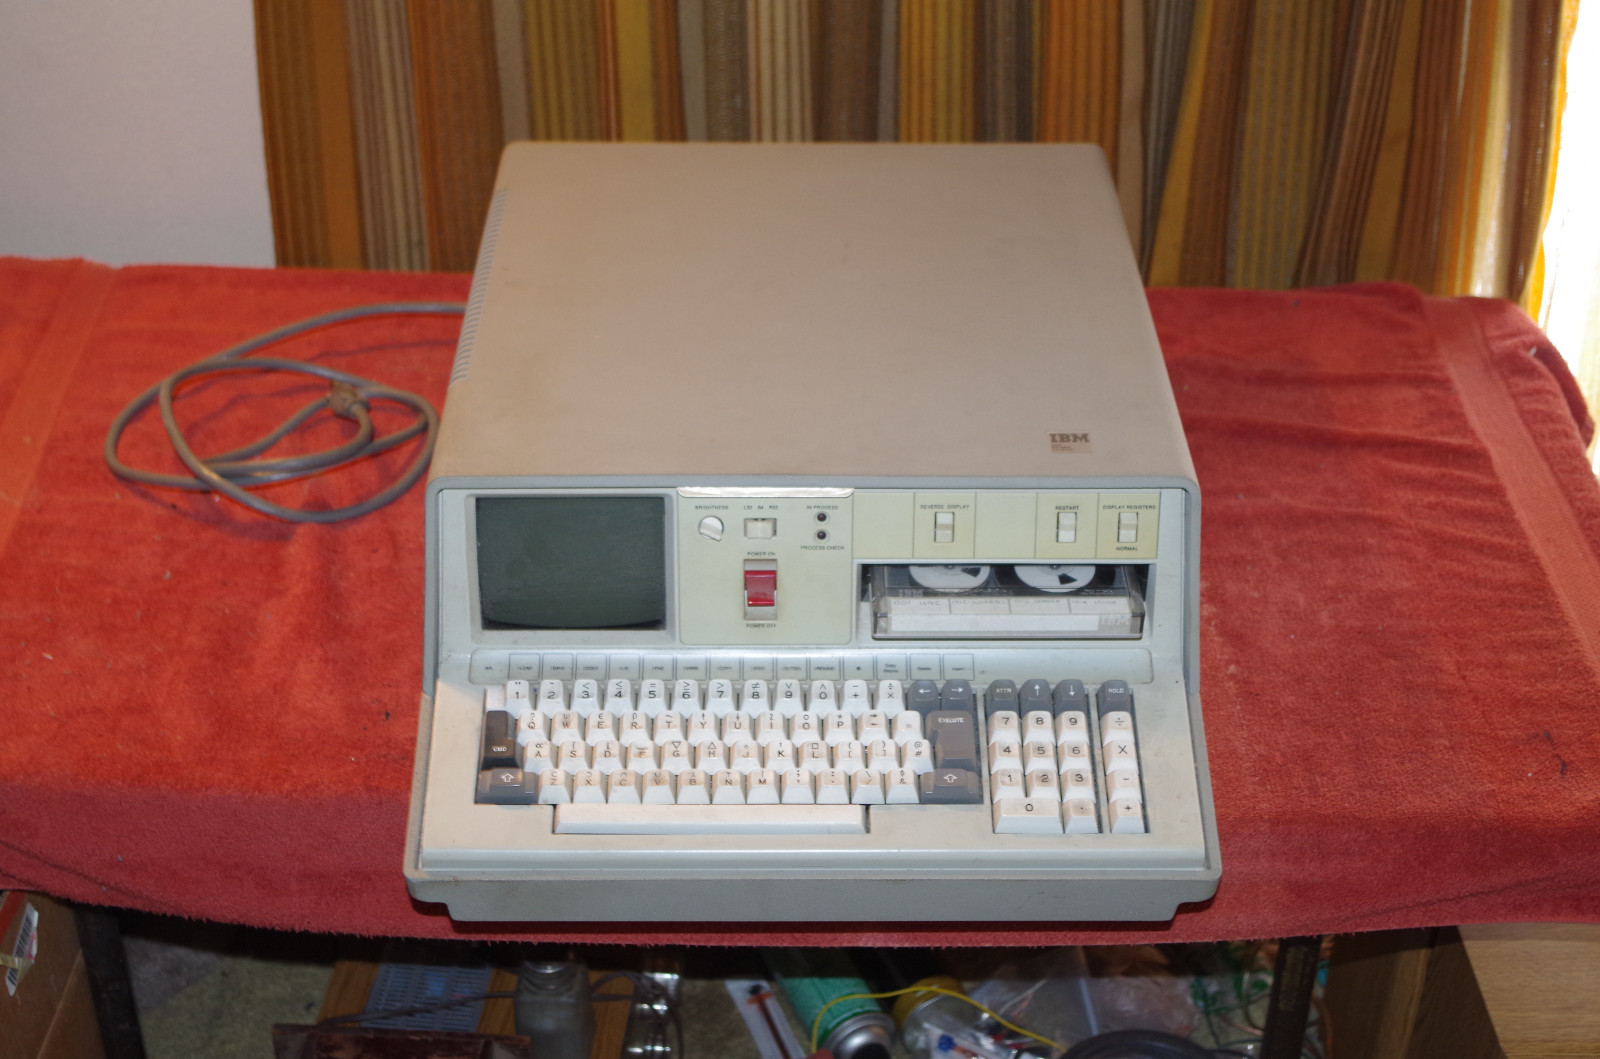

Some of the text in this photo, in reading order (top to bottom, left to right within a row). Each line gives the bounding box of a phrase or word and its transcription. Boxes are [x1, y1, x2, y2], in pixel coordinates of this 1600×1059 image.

[1050, 433, 1090, 442] IBM
[516, 691, 520, 699] 1
[548, 691, 555, 699] 2
[682, 691, 690, 699] 6
[752, 691, 759, 699] 8
[785, 691, 793, 699] 9
[819, 691, 827, 699] 0
[1036, 717, 1044, 725] 8
[1003, 746, 1011, 754] 4
[1037, 746, 1045, 754] 5
[1072, 746, 1080, 754] 6
[1076, 774, 1083, 782] 3
